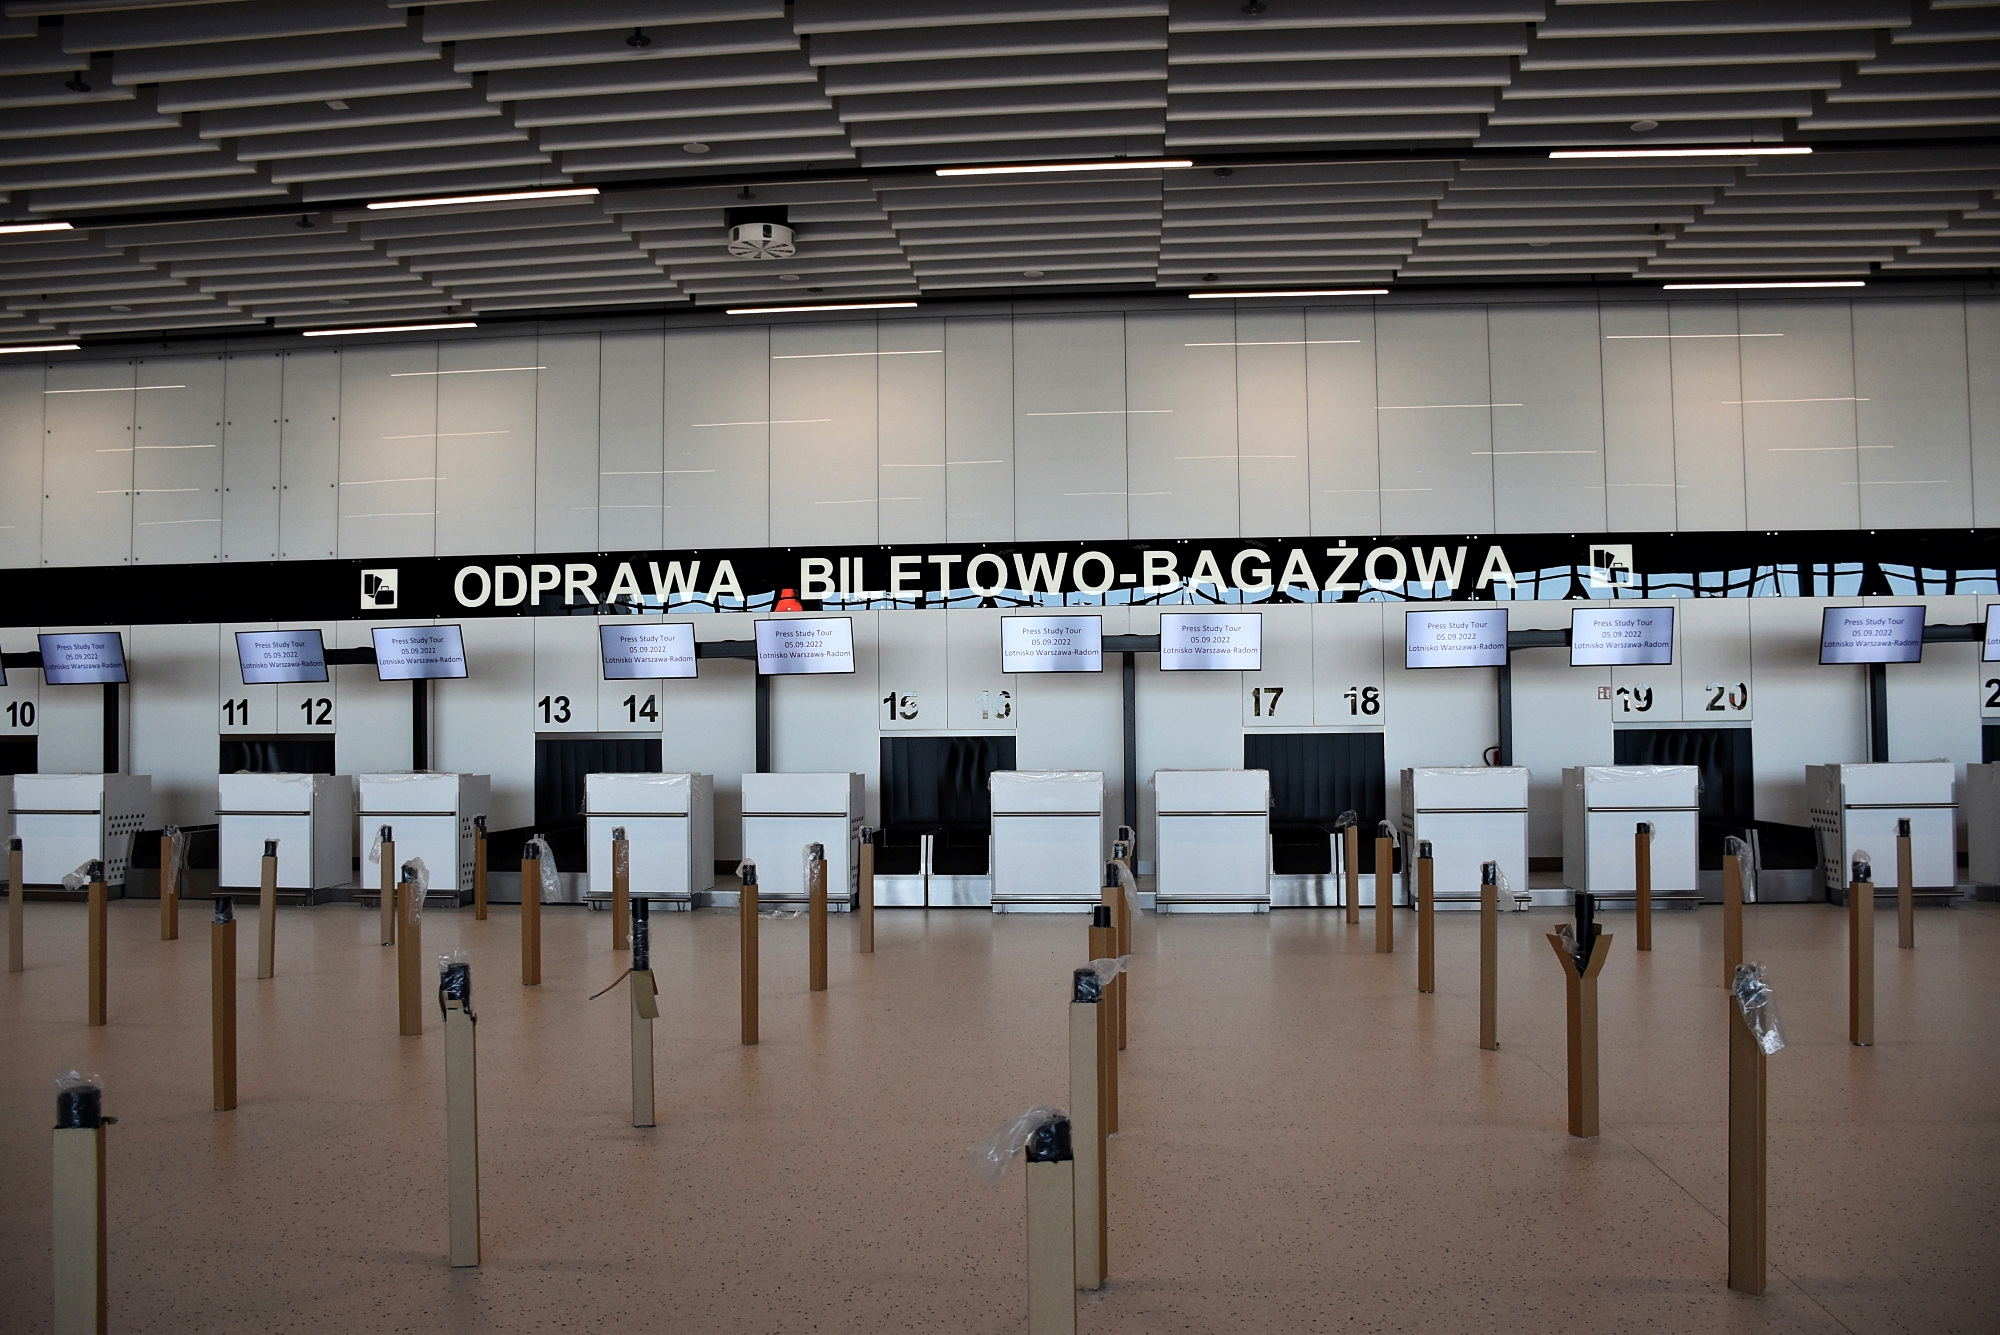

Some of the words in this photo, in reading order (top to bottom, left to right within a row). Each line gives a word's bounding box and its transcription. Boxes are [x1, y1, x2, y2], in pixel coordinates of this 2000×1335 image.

[454, 560, 745, 607] ODPRAWA
[800, 540, 1518, 600] BILETOWO-BAGAŻOWA
[1427, 622, 1447, 630] Press
[1448, 621, 1469, 631] Study
[1470, 621, 1488, 629] Tour
[1614, 619, 1635, 628] Study
[1865, 618, 1886, 627] Study
[795, 630, 815, 638] Study
[1022, 627, 1041, 635] Press
[1043, 627, 1064, 636] Study
[1202, 625, 1223, 634] Study
[1601, 630, 1642, 638] 05.09.2022
[1852, 629, 1893, 637] 05.09.2022
[410, 637, 428, 645] Study
[620, 635, 638, 643] Press
[639, 635, 659, 644] Study
[1190, 636, 1230, 644] 05.09.2022
[1436, 633, 1476, 641] 05.09.2022
[272, 641, 290, 649] Study
[784, 641, 823, 649] 05.09.2022
[1031, 638, 1071, 646] 05.09.2022
[1605, 641, 1669, 649] Warszawa-Radom
[1824, 640, 1854, 648] Lotnisko
[1855, 639, 1919, 647] Warszawa-Radom
[73, 643, 91, 651] Study
[401, 647, 436, 655] 05.09.2022
[629, 646, 666, 654] 05.09.2022
[1194, 646, 1258, 654] Warszawa-Radom
[1408, 644, 1439, 652] Lotnisko
[1440, 643, 1505, 651] Warszawa-Radom
[264, 651, 298, 659] 05.09.2022
[759, 651, 789, 659] Lotnisko
[790, 650, 851, 659] Warszawa-Radom
[1036, 648, 1099, 656] Warszawa-Radom
[65, 653, 98, 661] 05.09.2022
[379, 657, 405, 665] Lotnisko
[405, 656, 463, 664] Warszawa-Radom
[605, 656, 633, 664] Lotnisko
[633, 655, 694, 663] Warszawa-Radom
[45, 663, 70, 671] Lotnisko
[269, 660, 323, 669] Warszawa-Radom
[1343, 686, 1380, 715] 18
[1616, 682, 1653, 712] 19
[1705, 682, 1748, 711] 20
[883, 690, 919, 721] 15
[975, 690, 1011, 720] 16
[1251, 687, 1284, 717] 17
[222, 699, 248, 726] 11
[300, 698, 333, 725] 12
[538, 695, 571, 724] 13
[623, 694, 659, 723] 14
[6, 701, 35, 728] 10
